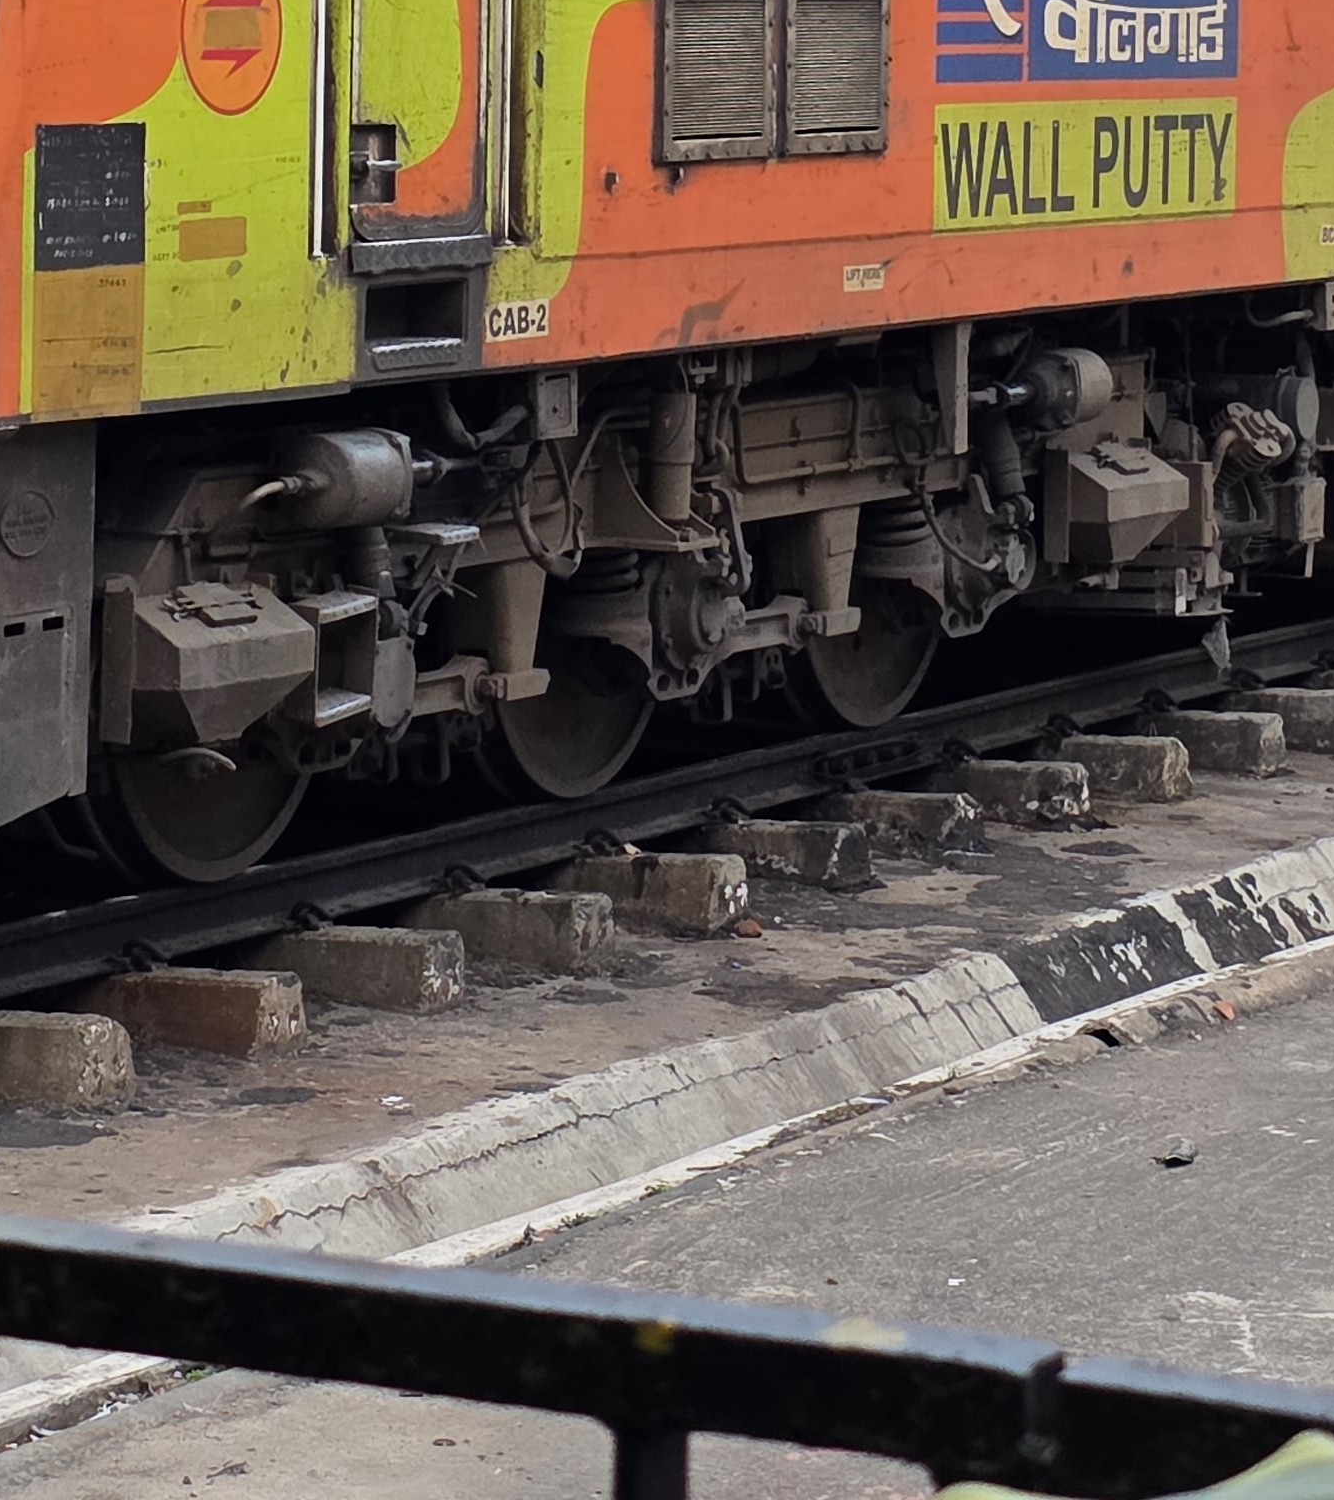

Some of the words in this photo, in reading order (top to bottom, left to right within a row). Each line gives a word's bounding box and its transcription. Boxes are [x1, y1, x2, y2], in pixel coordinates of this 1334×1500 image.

[940, 120, 1076, 220] WALL
[1092, 112, 1233, 209] PUTTY
[488, 303, 547, 338] CAB-2
